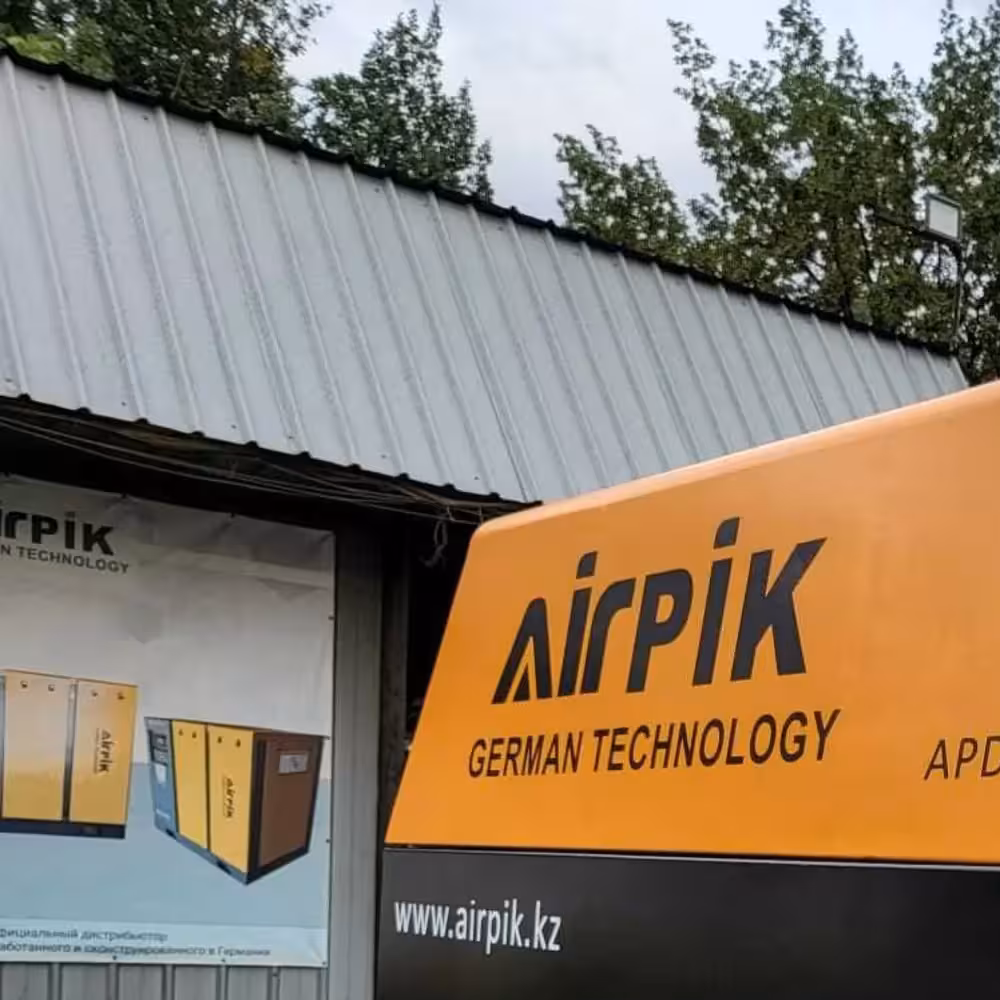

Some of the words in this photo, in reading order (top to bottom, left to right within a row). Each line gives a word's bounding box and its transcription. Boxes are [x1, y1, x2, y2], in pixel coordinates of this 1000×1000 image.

[16, 545, 130, 573] TECHNOLOGY
[468, 731, 584, 778] GERMAN
[592, 708, 842, 772] TECHNOLOGY
[394, 899, 562, 954] www.airpik.kz
